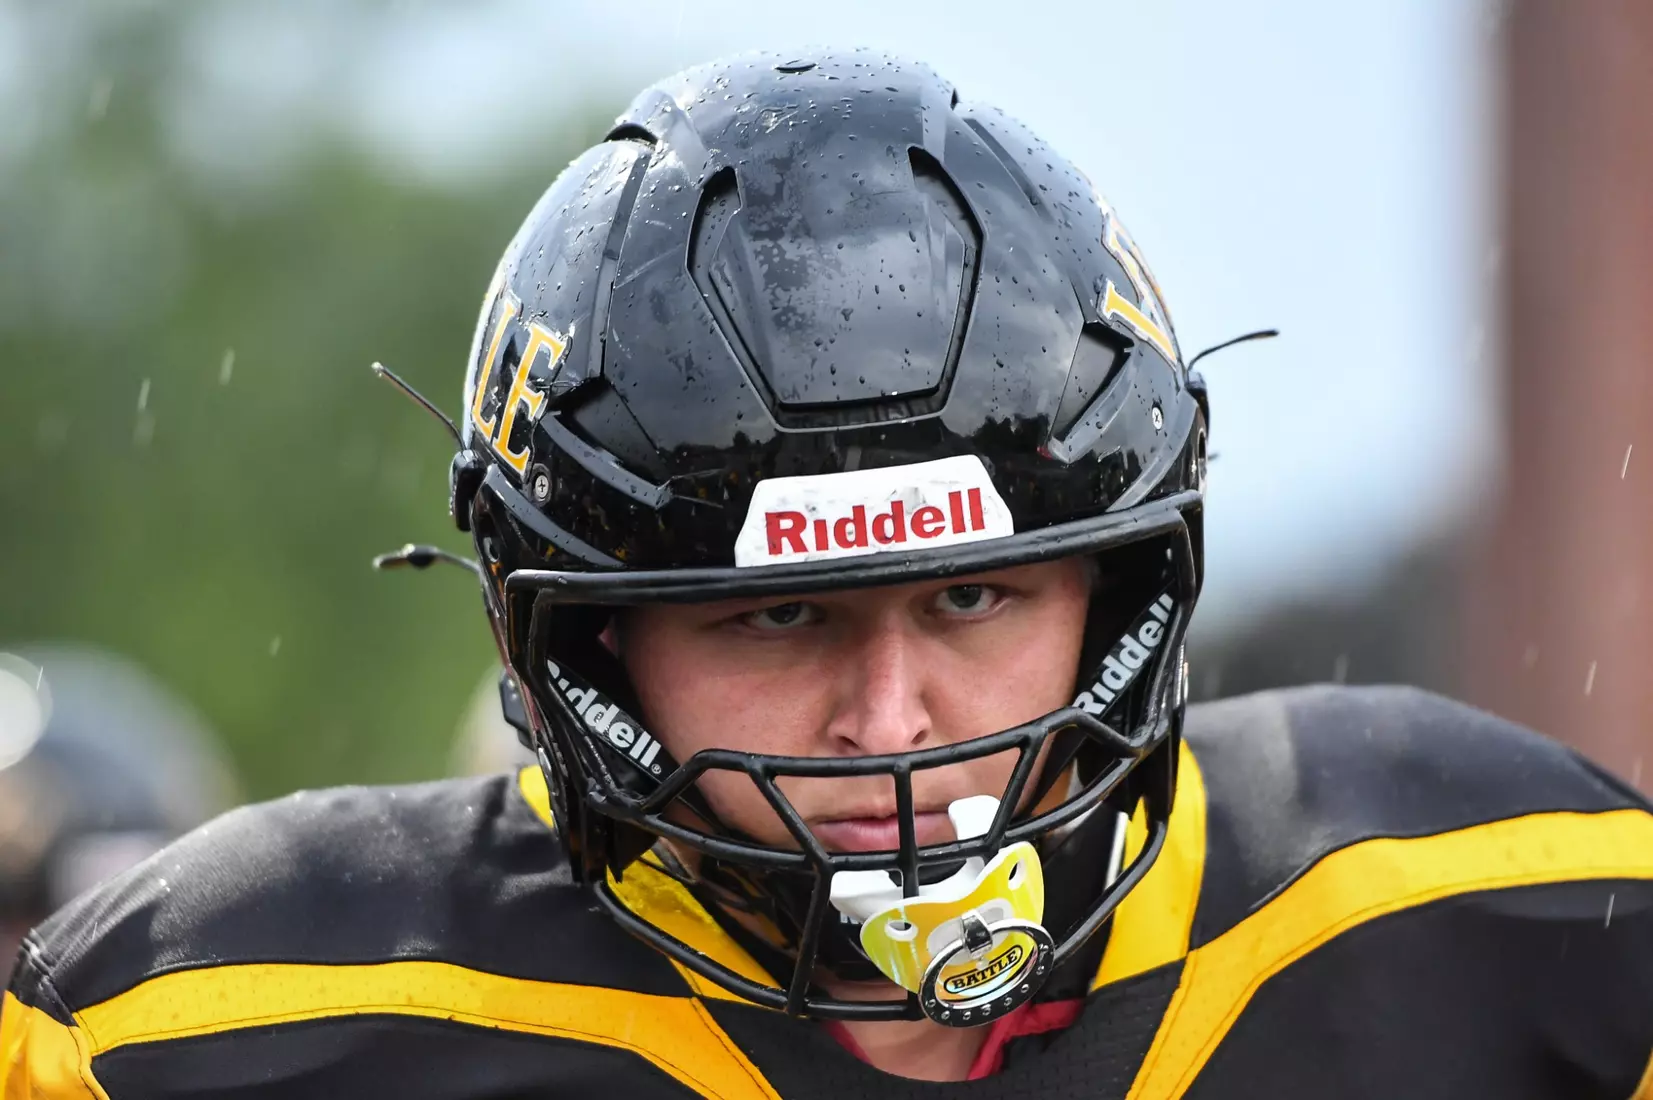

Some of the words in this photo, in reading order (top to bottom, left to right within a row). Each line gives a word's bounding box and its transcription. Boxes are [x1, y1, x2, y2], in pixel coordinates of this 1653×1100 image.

[765, 487, 985, 555] Riddell
[547, 659, 661, 768] ddell
[952, 950, 1018, 989] BATTLE
